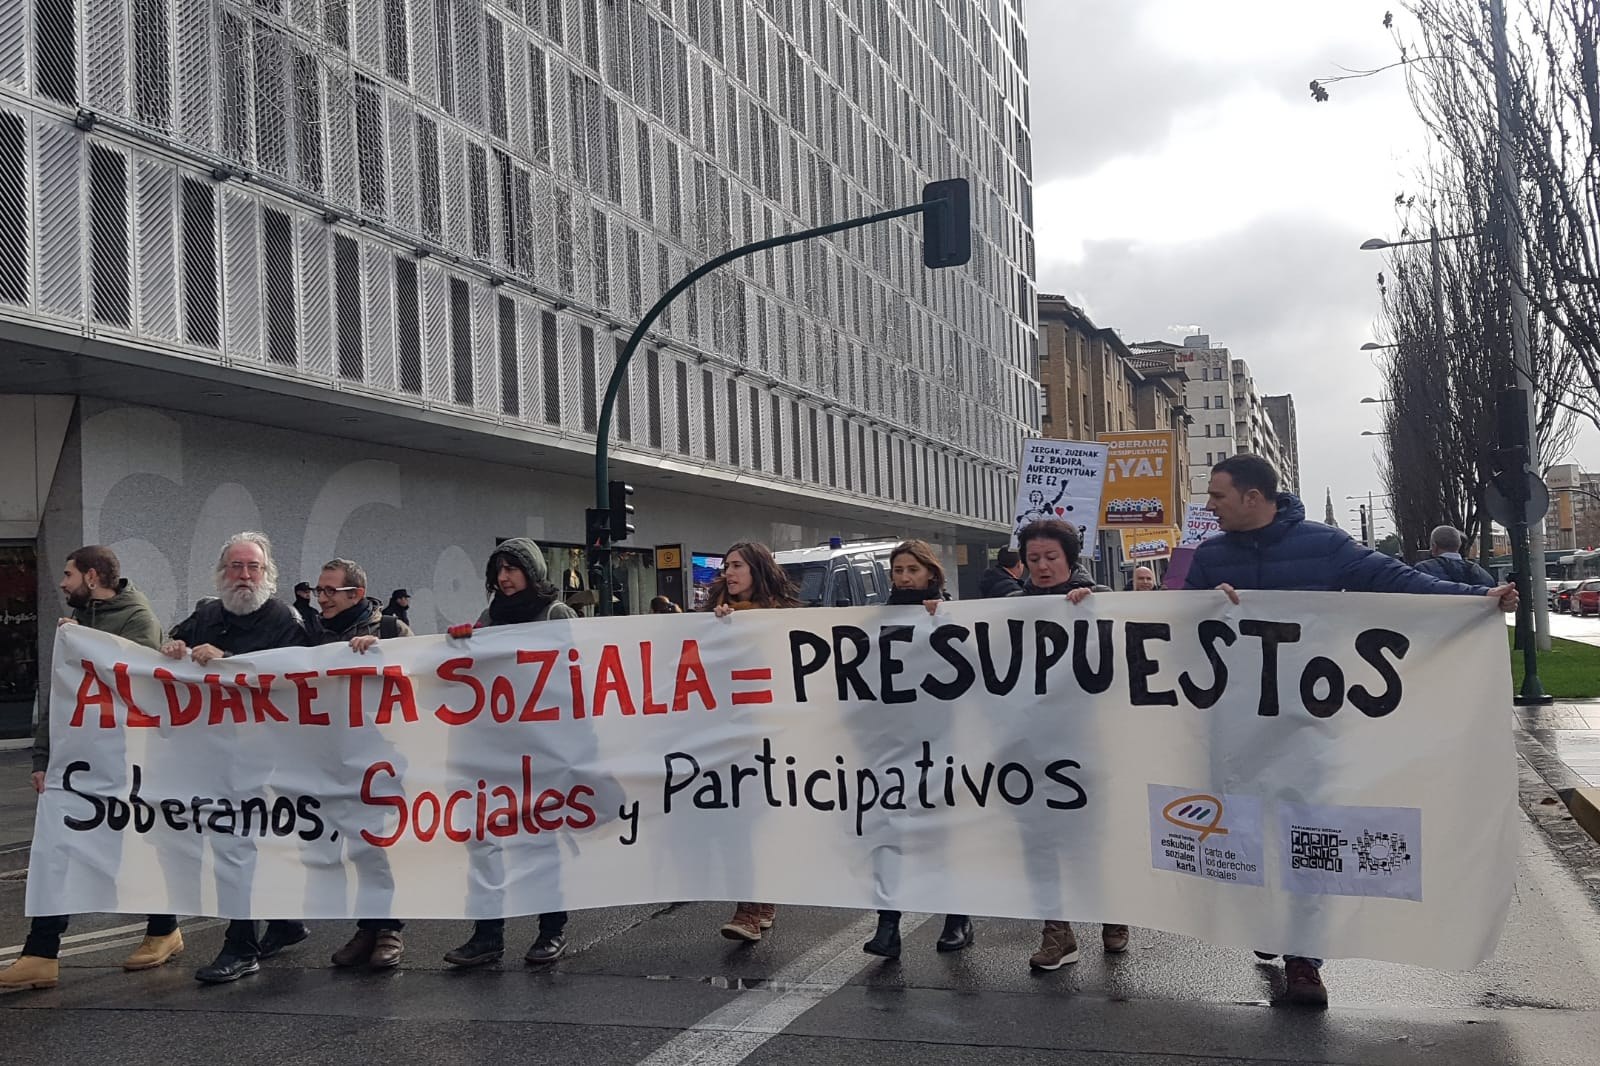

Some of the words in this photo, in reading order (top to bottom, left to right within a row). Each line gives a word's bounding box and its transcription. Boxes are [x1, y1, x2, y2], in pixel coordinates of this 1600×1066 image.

[1109, 439, 1168, 449] OBERANIA
[1034, 455, 1045, 463] EZ
[1065, 449, 1099, 457] ZUZENAK
[1027, 464, 1097, 477] AURREKONTUAK
[1108, 457, 1163, 482] ¡YA!
[1026, 474, 1043, 484] ERE
[1046, 475, 1057, 486] EZ
[69, 659, 419, 728] ALDAKETA
[360, 755, 596, 847] Sociales
[619, 800, 639, 845] y
[663, 738, 1087, 836] Participativos
[1161, 838, 1195, 852] eskubide
[1165, 849, 1195, 862] sozialen
[1204, 848, 1222, 858] carta
[1224, 850, 1236, 859] de
[1176, 860, 1196, 872] karta
[1205, 857, 1215, 866] los
[1216, 859, 1257, 872] derechos
[1206, 867, 1237, 880] sociales
